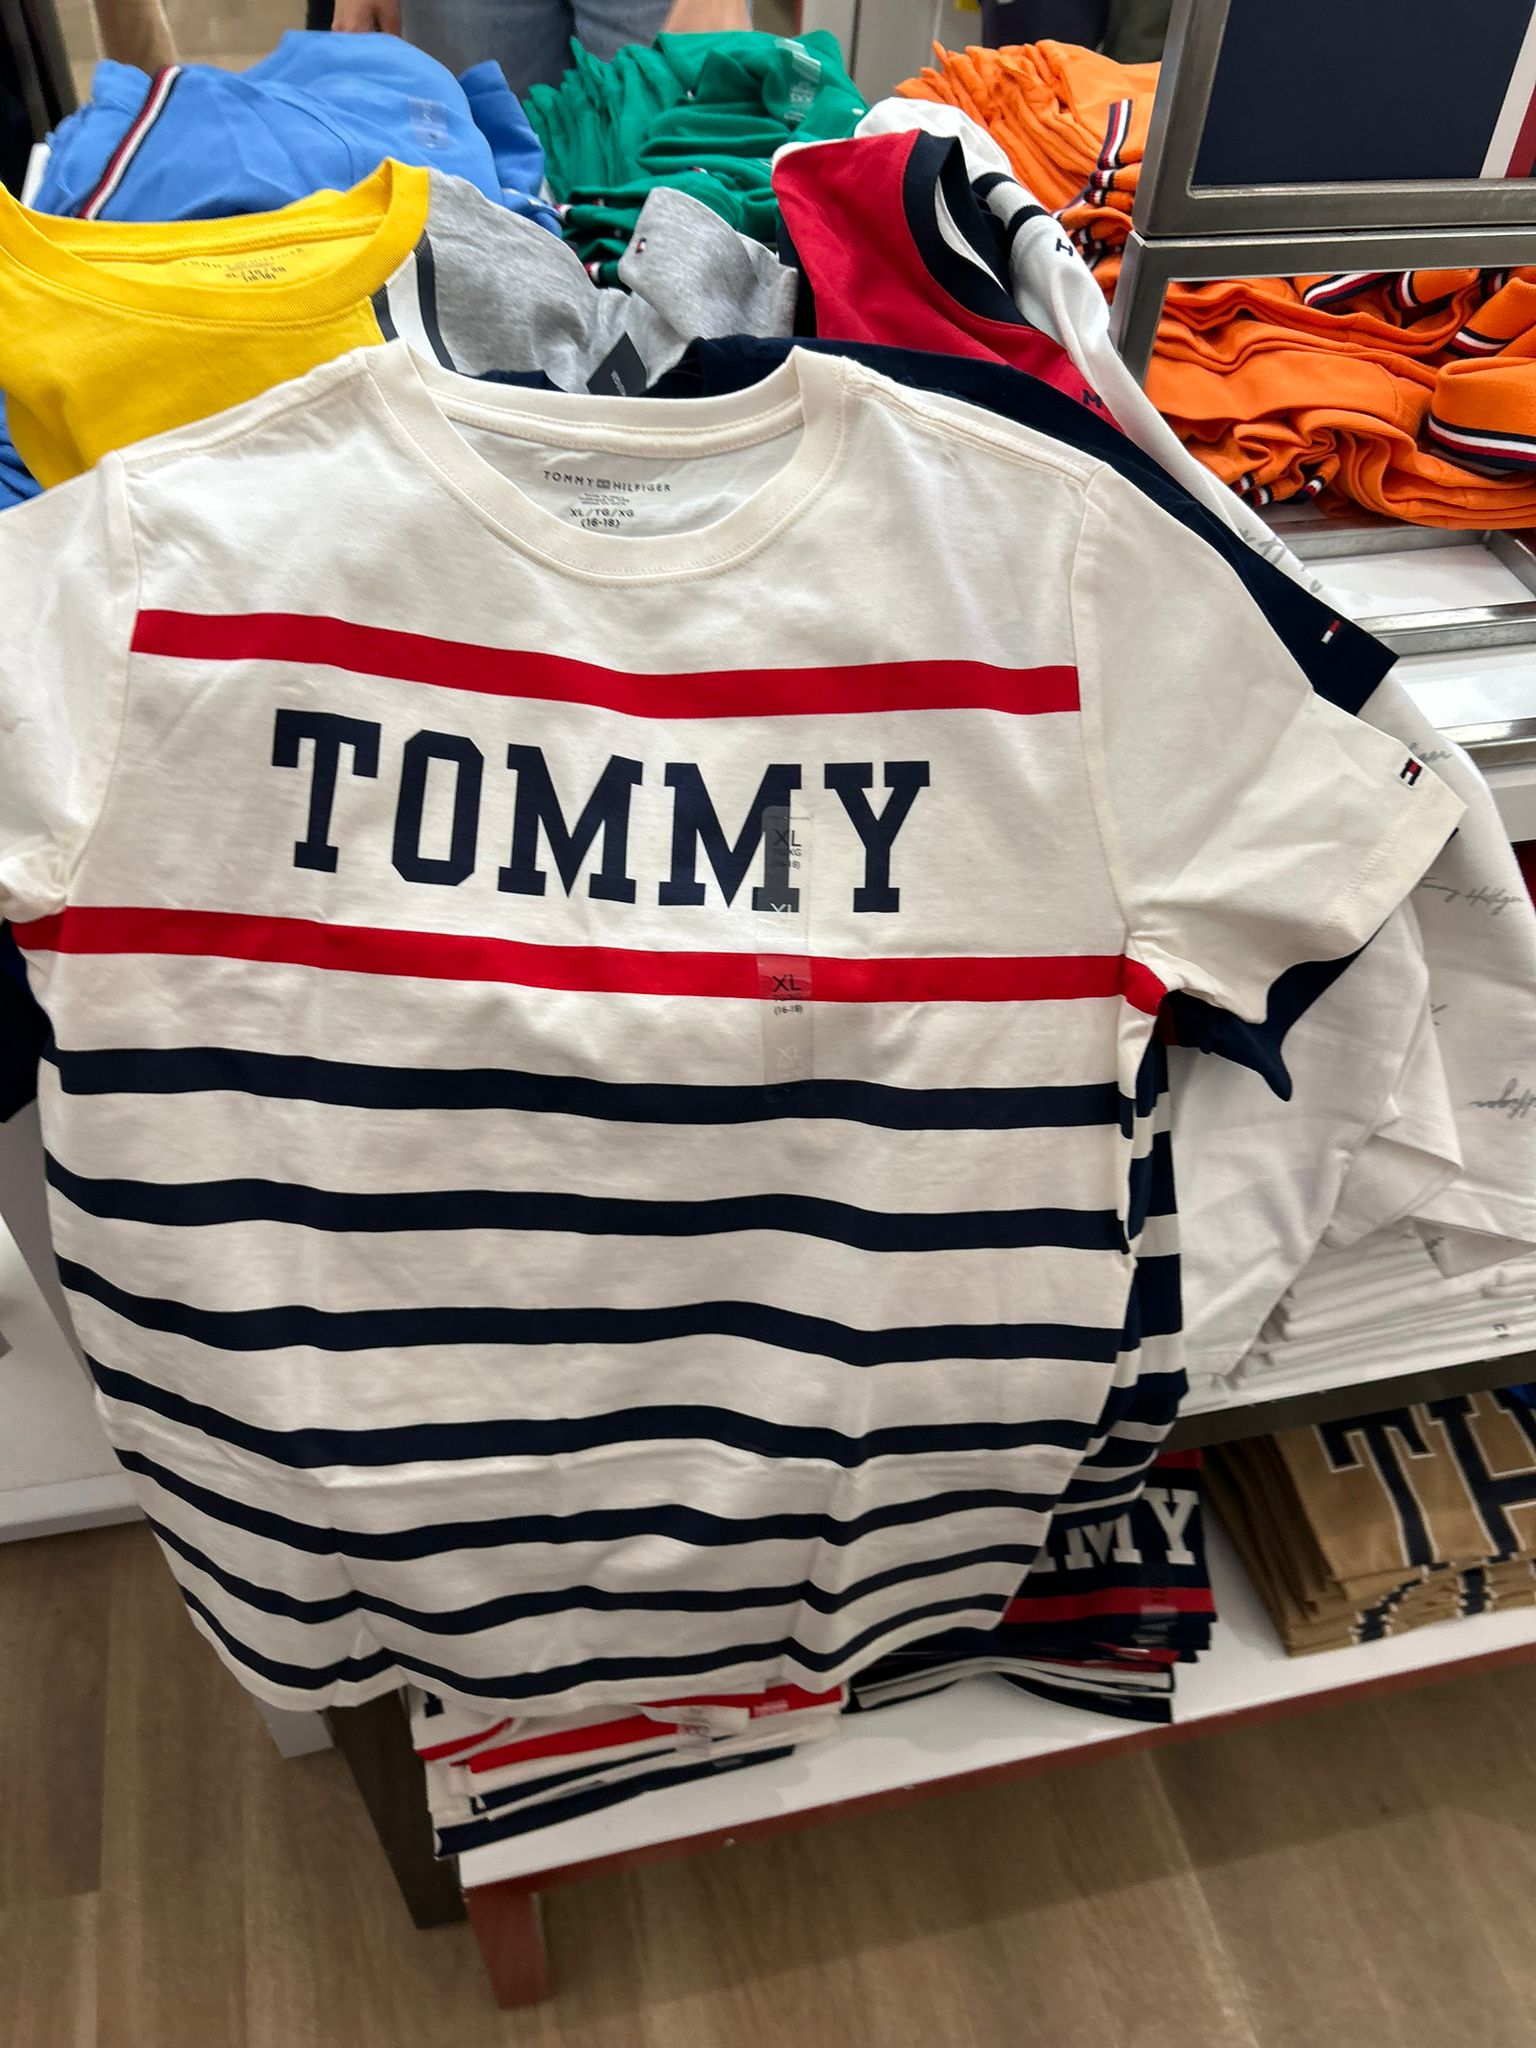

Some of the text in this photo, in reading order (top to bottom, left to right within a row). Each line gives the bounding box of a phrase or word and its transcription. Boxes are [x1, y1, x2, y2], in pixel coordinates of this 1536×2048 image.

[543, 470, 672, 493] TOMMY HILFIGER
[272, 708, 931, 914] TOMMY
[772, 829, 802, 847] XL
[772, 974, 802, 993] XL
